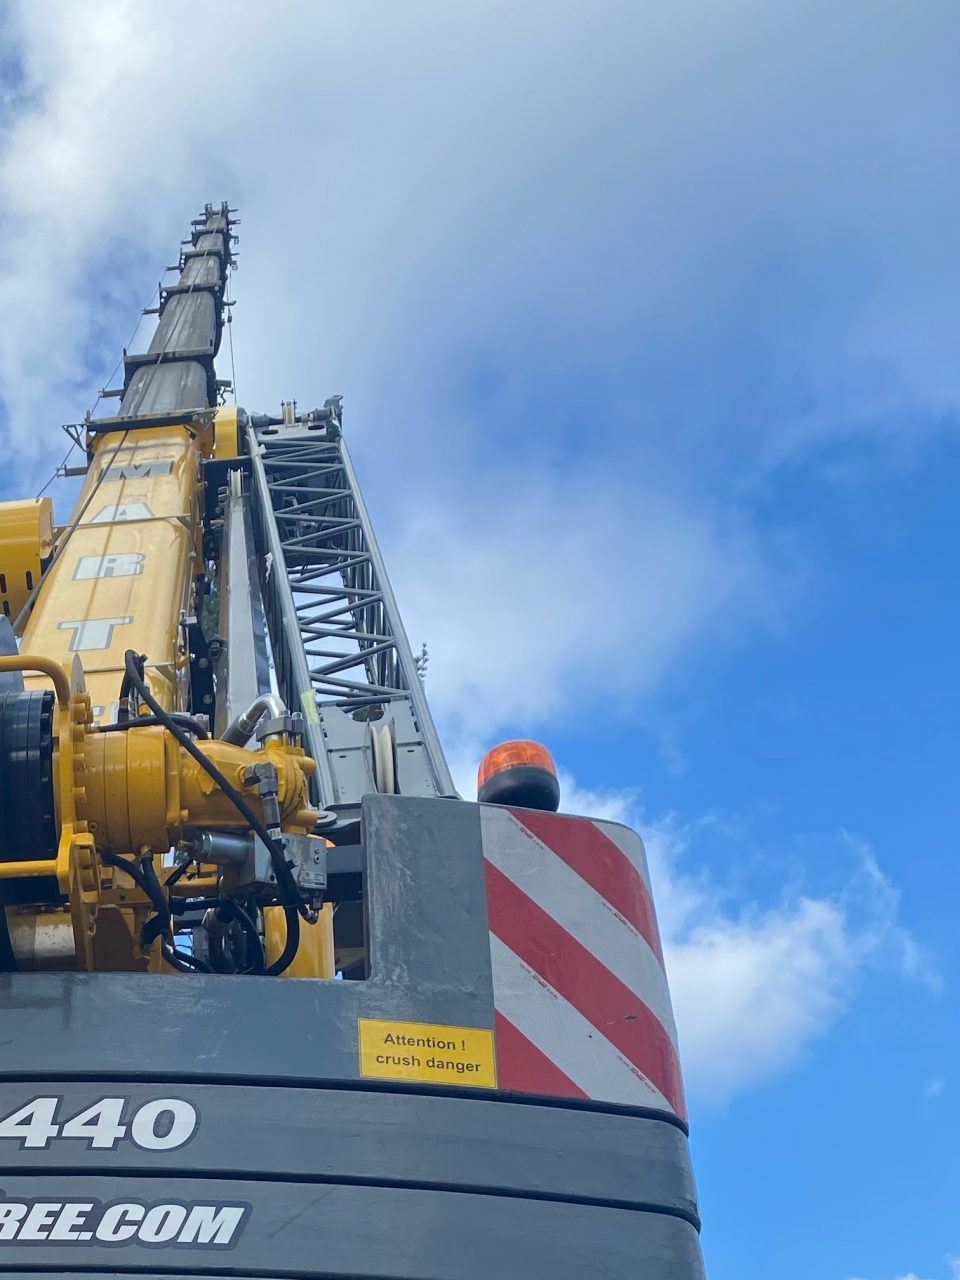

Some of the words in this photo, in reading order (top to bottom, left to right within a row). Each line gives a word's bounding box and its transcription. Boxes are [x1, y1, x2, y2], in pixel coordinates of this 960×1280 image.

[383, 1033, 456, 1050] Attention
[376, 1055, 421, 1067] crush
[426, 1057, 481, 1073] danger
